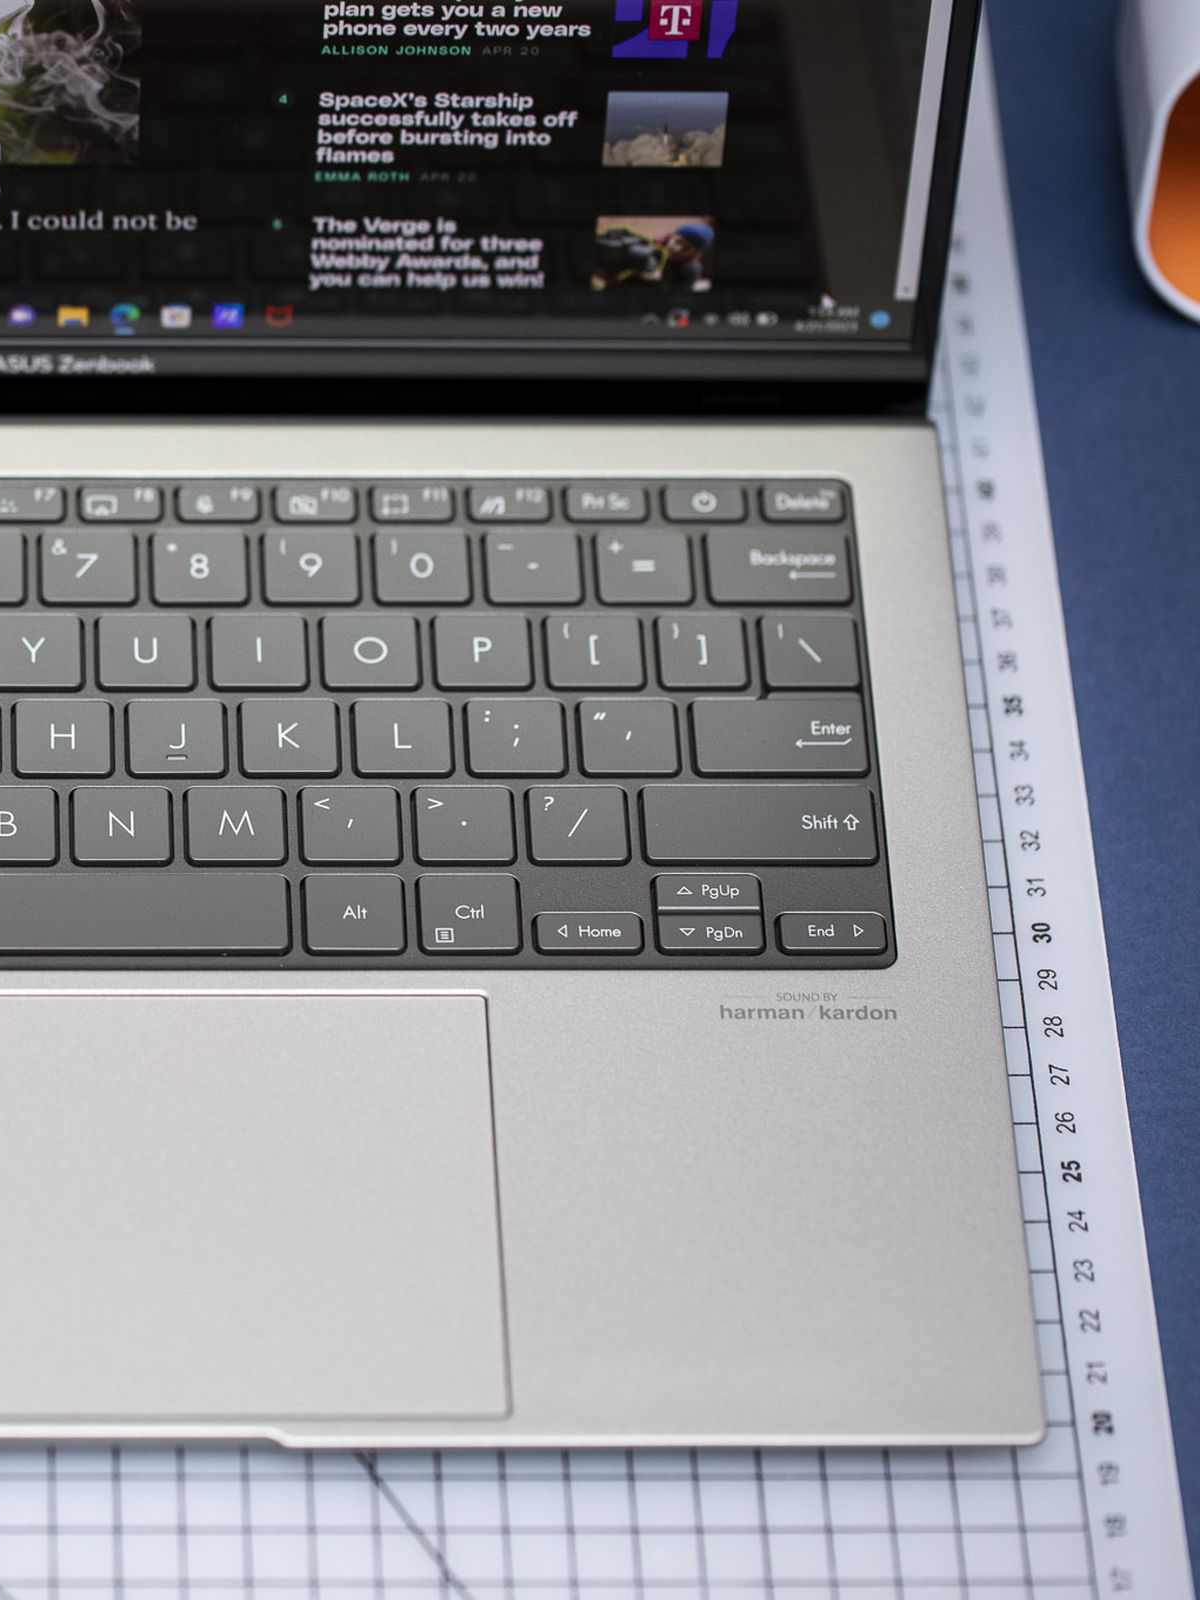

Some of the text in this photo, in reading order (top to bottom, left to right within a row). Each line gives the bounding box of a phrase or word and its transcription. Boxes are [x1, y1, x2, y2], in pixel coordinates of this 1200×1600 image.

[324, 1, 563, 20] plan gets you a new
[323, 20, 591, 40] phone every two years
[321, 45, 539, 56] ALLISON JOHNSON APR 20
[279, 95, 287, 103] 4
[319, 92, 533, 112] SpaceX's Starship
[318, 110, 577, 130] successfully takes off
[318, 128, 551, 149] before bursting into
[316, 147, 394, 163] flames
[314, 171, 409, 182] EMMA ROTH
[12, 211, 18, 230] I
[28, 210, 103, 230] could
[113, 214, 156, 230] not
[166, 211, 197, 230] be
[313, 217, 456, 237] The Verge is
[312, 235, 543, 252] nominated for three
[311, 252, 390, 273] Webby
[494, 254, 539, 269] and
[310, 274, 352, 290] you
[357, 274, 401, 287] can
[407, 271, 457, 290] help
[462, 274, 490, 288] us
[58, 354, 155, 374] Zenbook
[76, 554, 98, 577] 7
[190, 554, 209, 578] 8
[299, 553, 322, 577] 9
[22, 638, 45, 662] Y
[134, 638, 157, 663] U
[257, 637, 261, 662] I
[354, 637, 387, 663] O
[473, 637, 492, 662] P
[51, 724, 75, 749] H
[170, 724, 185, 749] J
[278, 723, 299, 748] K
[394, 723, 412, 748] L
[811, 721, 851, 735] Enter
[1010, 741, 1029, 760] 34
[1014, 785, 1035, 806] 33
[109, 811, 134, 836] N
[219, 810, 254, 835] M
[802, 815, 838, 829] Shift
[1020, 831, 1040, 851] 32
[702, 885, 739, 899] PgUp
[1026, 879, 1046, 896] 31
[343, 905, 367, 919] Alt
[455, 905, 484, 919] Ctrl
[579, 926, 621, 937] Home
[707, 927, 742, 941] PgDn
[808, 925, 834, 936] End
[1031, 923, 1052, 943] 30
[1037, 969, 1058, 990] 29
[776, 993, 837, 1001] SOUND BY
[1043, 1016, 1064, 1037] 28
[1048, 1064, 1070, 1085] 27
[1055, 1112, 1076, 1133] 26
[1061, 1161, 1082, 1182] 25
[1067, 1210, 1088, 1232] 24
[1073, 1259, 1094, 1282] 23
[1079, 1310, 1101, 1332] 22
[1086, 1362, 1107, 1383] 21
